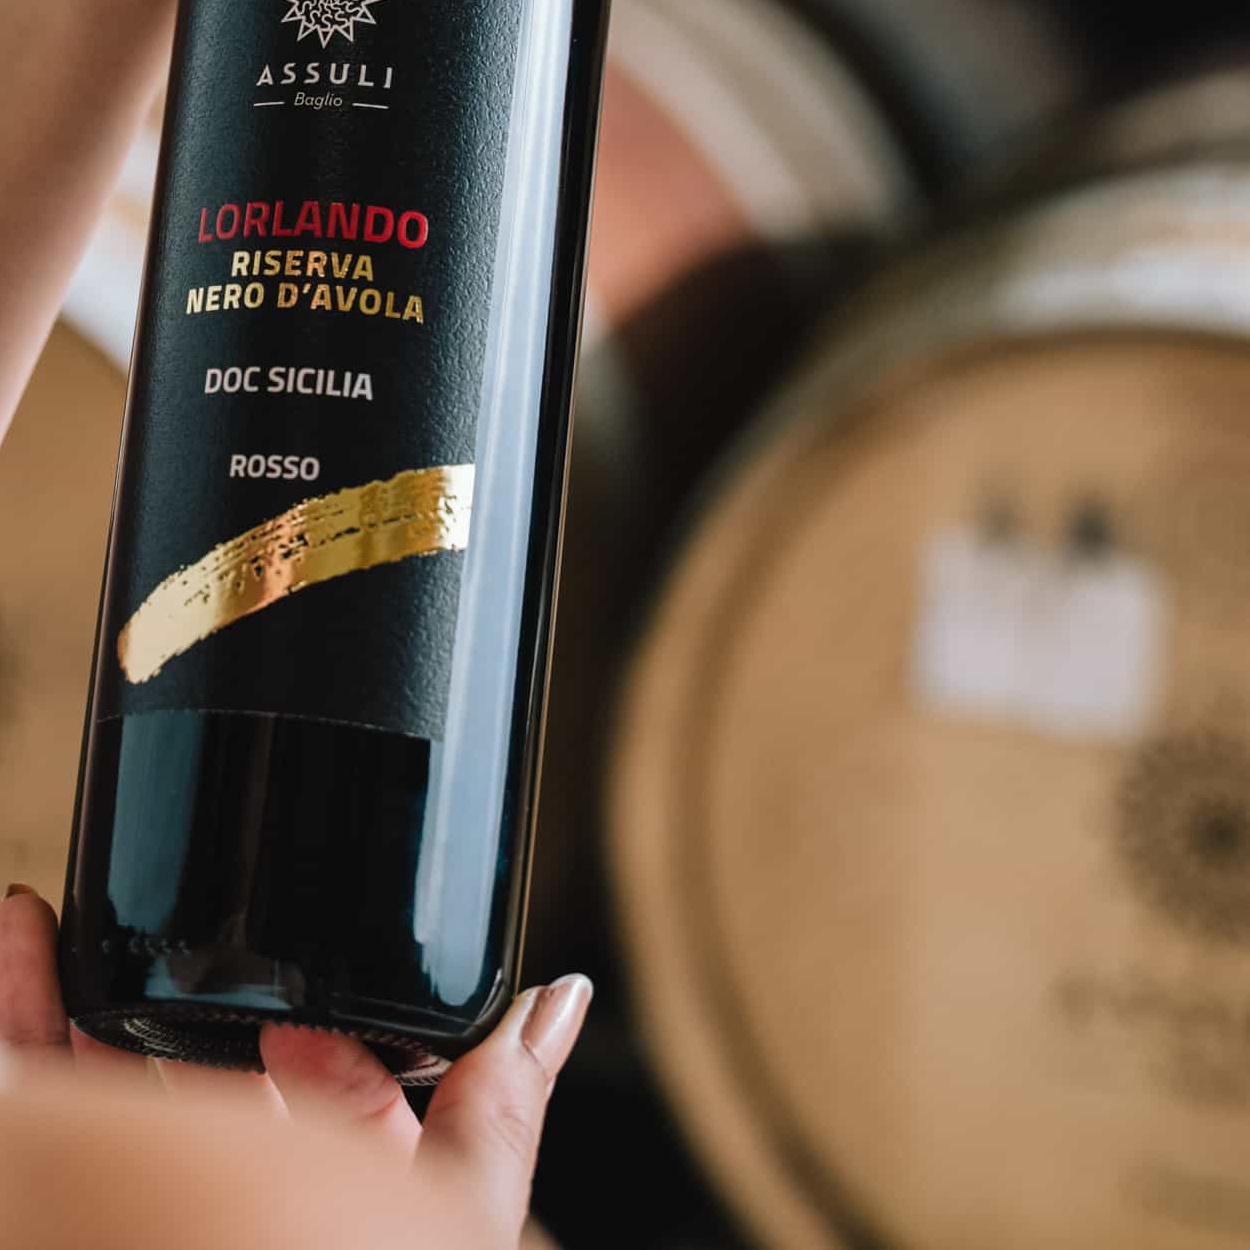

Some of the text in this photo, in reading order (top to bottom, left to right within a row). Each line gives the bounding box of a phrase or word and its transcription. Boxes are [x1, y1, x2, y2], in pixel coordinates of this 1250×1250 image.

[255, 61, 394, 89] ASSULI
[294, 91, 343, 110] Baglio
[197, 200, 429, 249] LORLANDO
[231, 250, 374, 282] RISERVA
[186, 282, 424, 324] NERO D'AVOLA
[204, 366, 373, 400] DOC SICILIA
[229, 454, 320, 480] ROSSO
